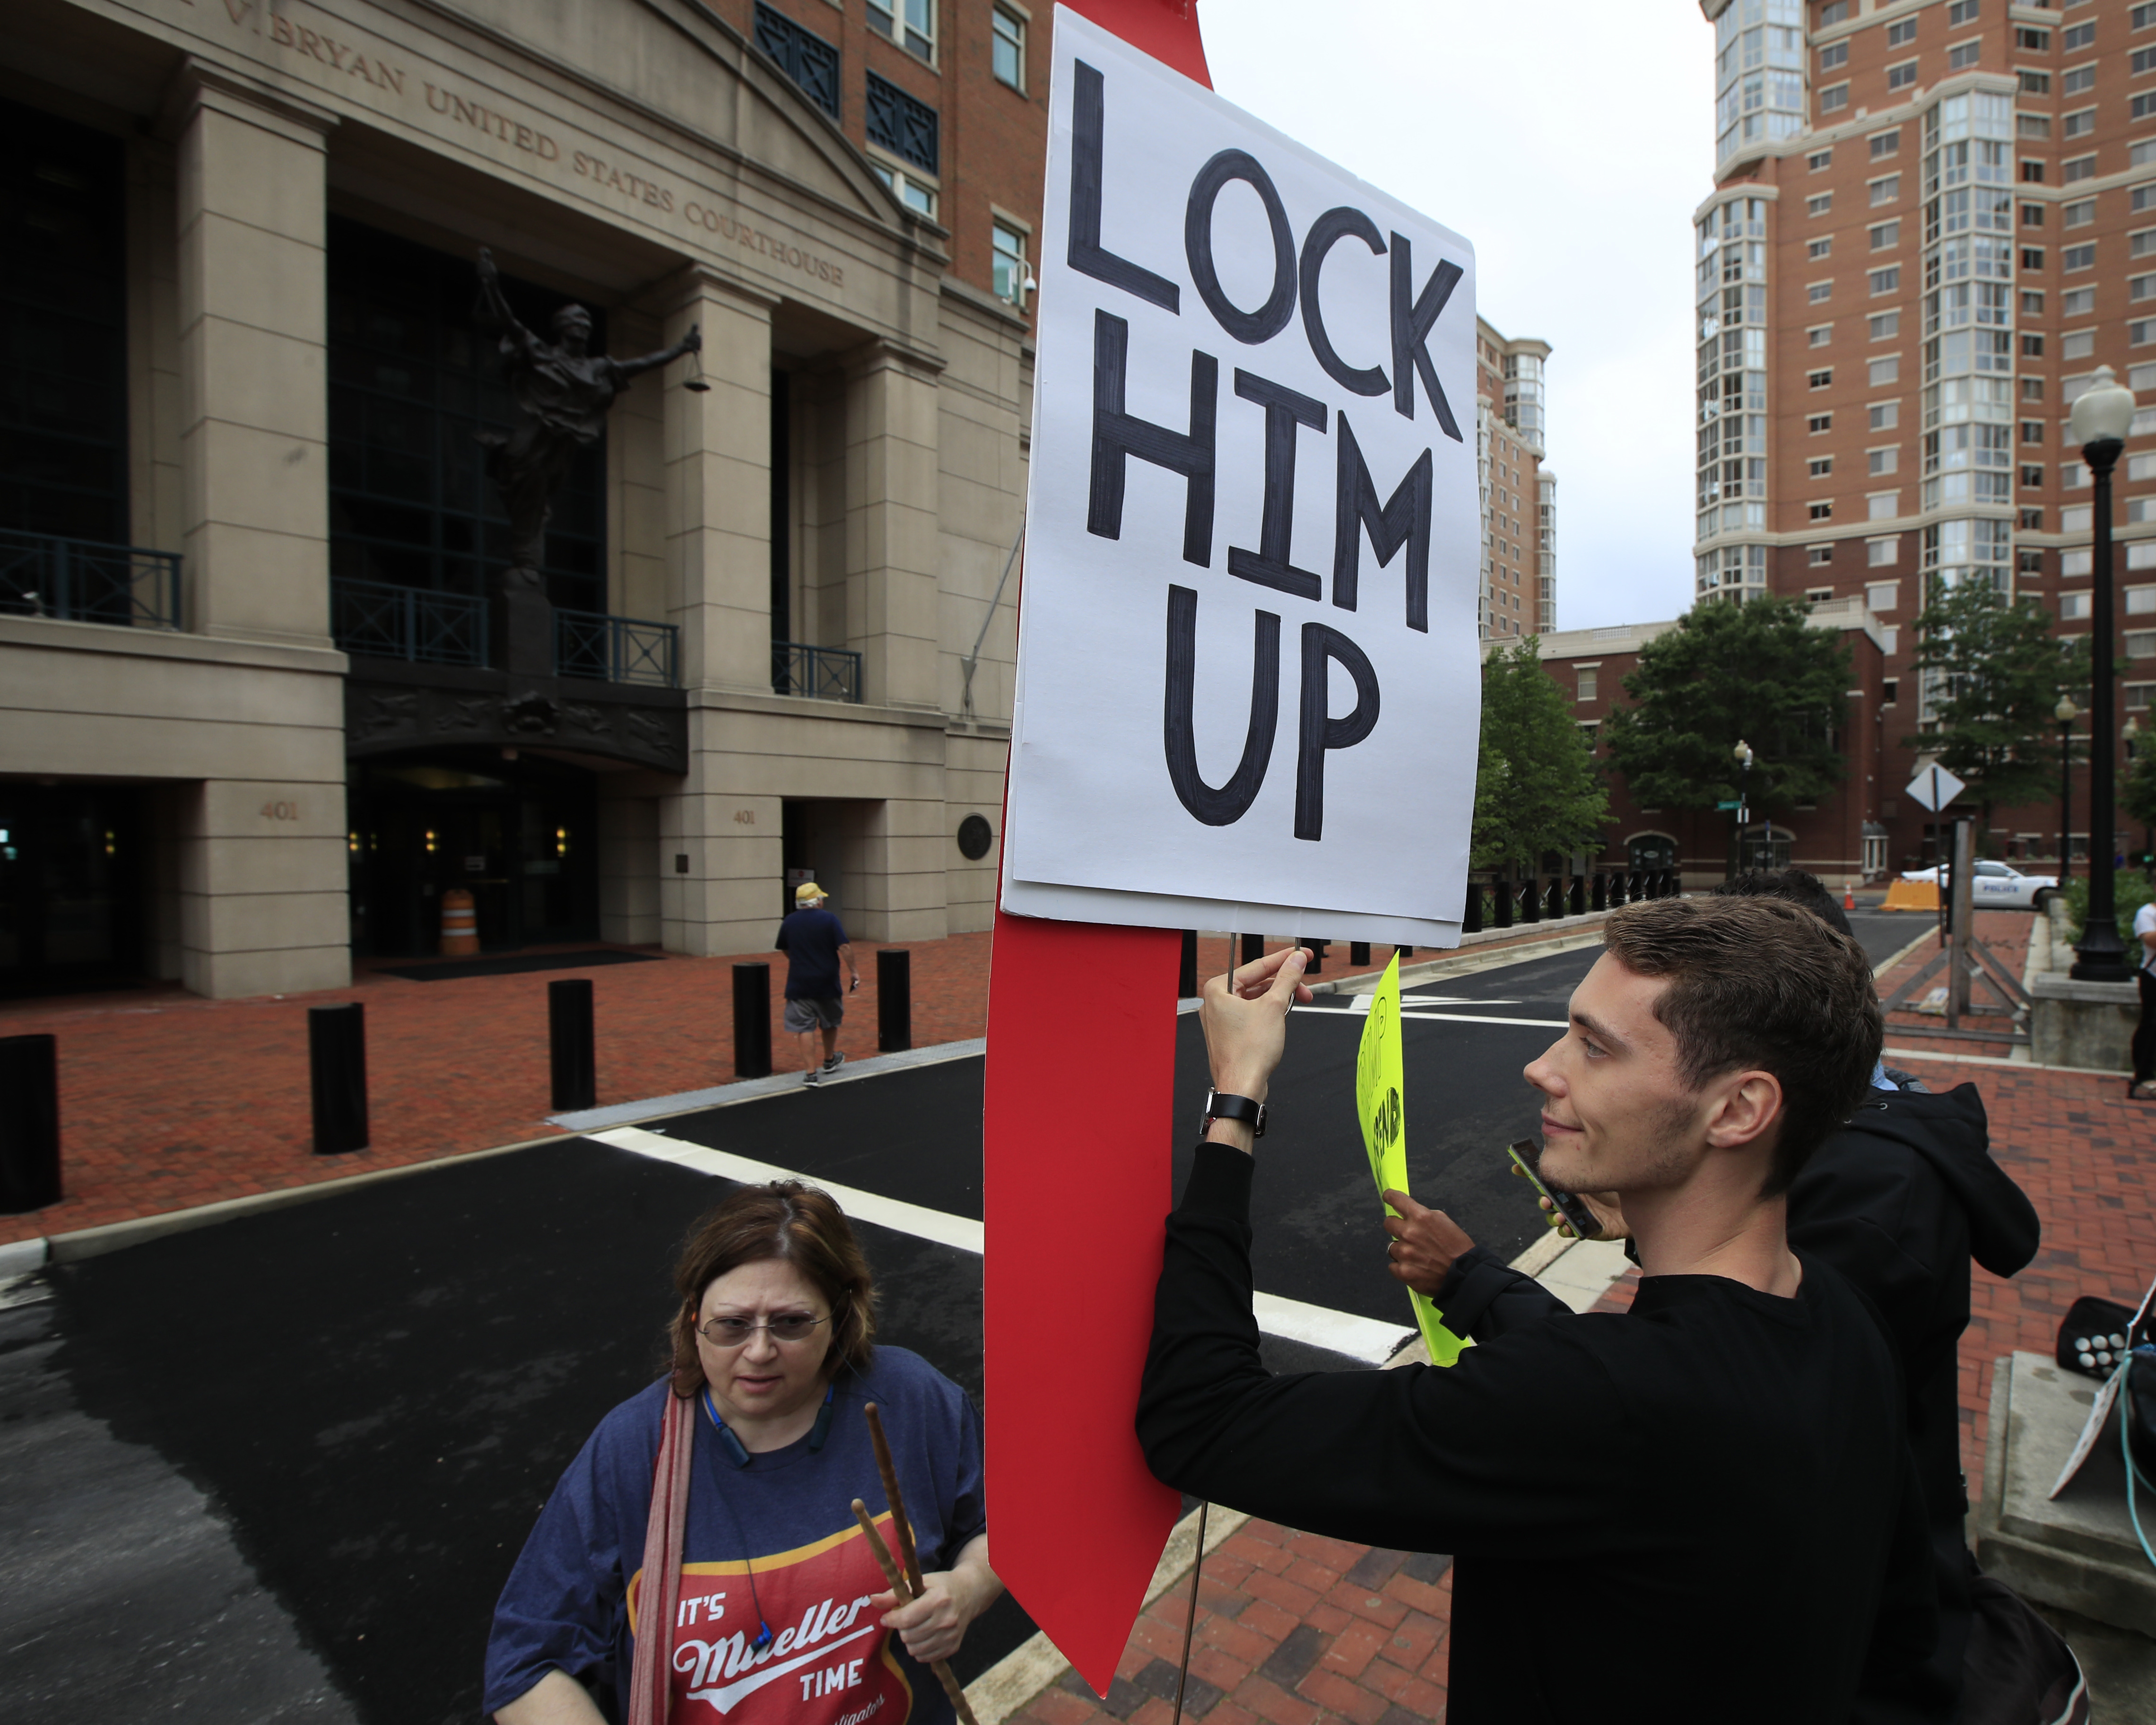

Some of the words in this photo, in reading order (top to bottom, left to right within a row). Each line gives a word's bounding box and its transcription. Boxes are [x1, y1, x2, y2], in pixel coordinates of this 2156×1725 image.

[269, 12, 406, 96] BRYAN
[422, 80, 560, 162] UNITED
[573, 150, 675, 213] STATES
[684, 201, 844, 288] COURTHOUSE
[1068, 57, 1464, 443] LOCK
[1087, 308, 1434, 633] HIM
[1164, 583, 1380, 841] UP
[260, 801, 298, 820] 401
[733, 810, 756, 824] 401
[672, 1595, 872, 1689] Mueller
[677, 1592, 726, 1627] IT'S
[800, 1658, 864, 1701] TIME
